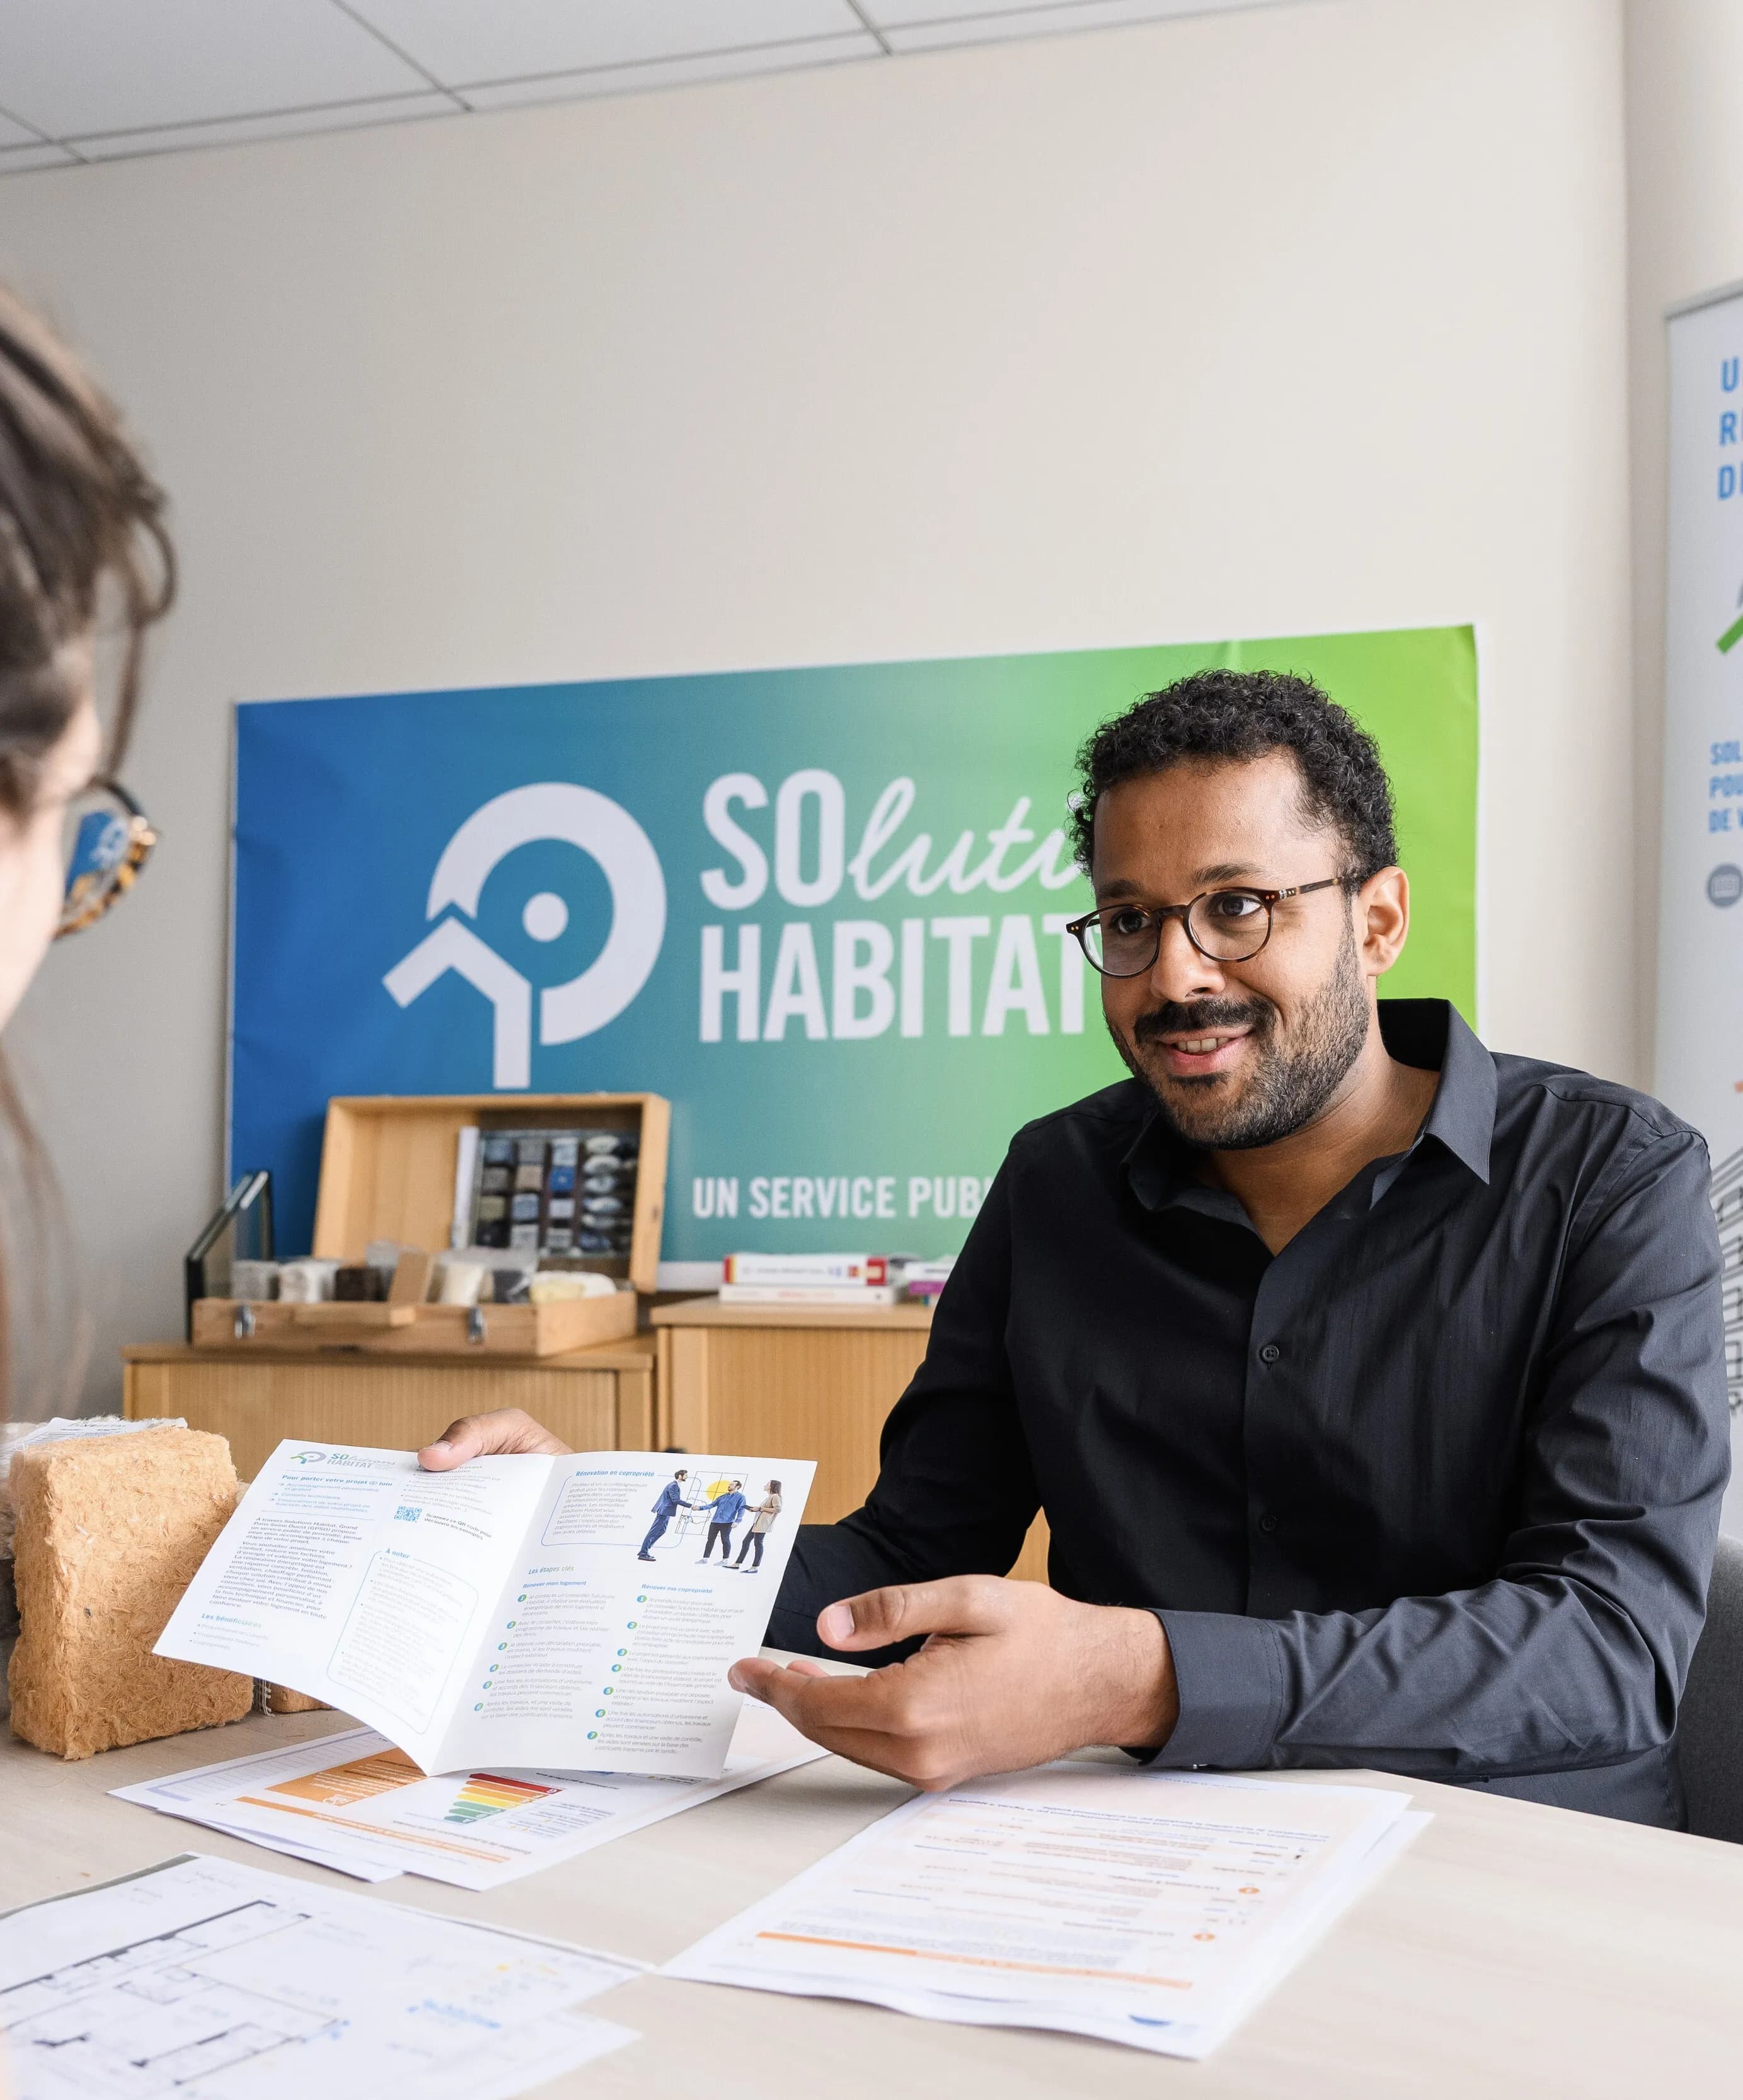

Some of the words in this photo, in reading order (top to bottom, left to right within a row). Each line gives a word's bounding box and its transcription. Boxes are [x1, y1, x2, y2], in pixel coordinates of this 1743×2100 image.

[1720, 355, 1743, 394] U
[1718, 410, 1743, 446] R
[1717, 461, 1743, 500] D
[699, 769, 1091, 910] SOluti
[698, 914, 1102, 1043] HABITAT
[693, 1176, 739, 1218] UN
[749, 1176, 897, 1217] SERVICE
[327, 1459, 374, 1469] HABITAT
[426, 1513, 449, 1521] Scannez
[480, 1530, 492, 1538] pour
[392, 1550, 410, 1559] noter
[216, 1615, 262, 1628] bénéficiaires
